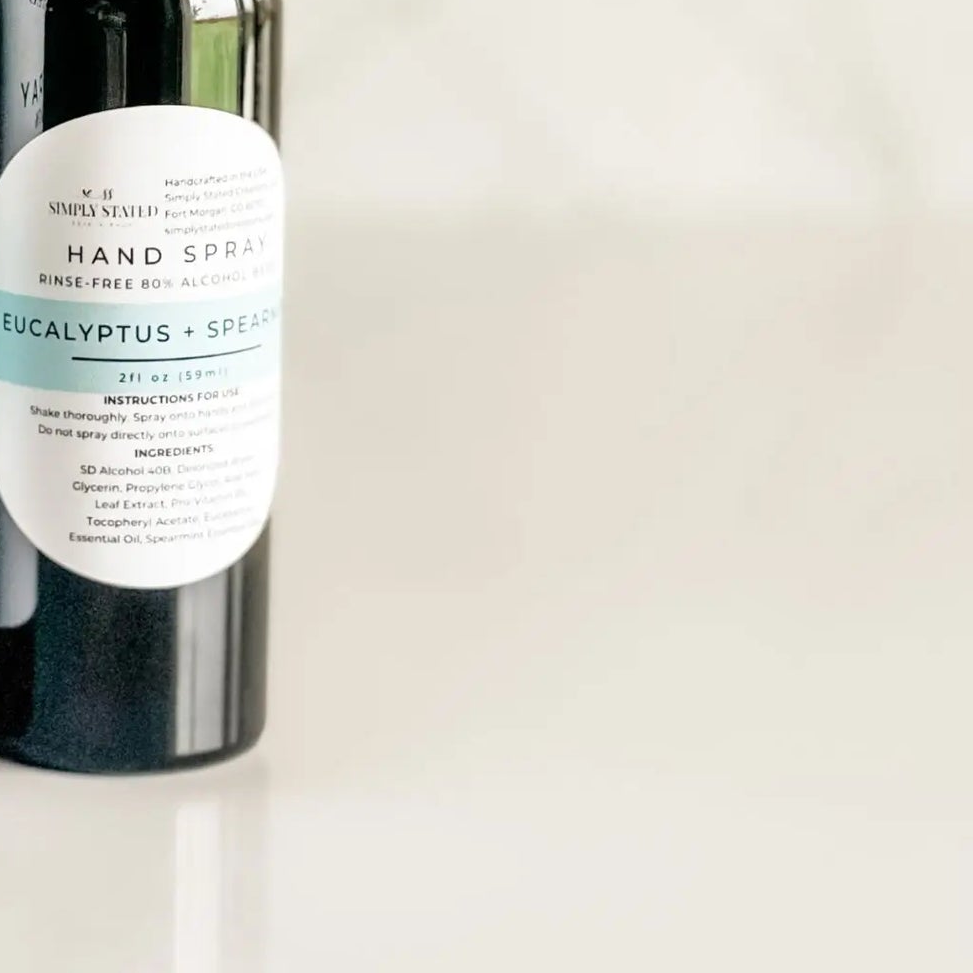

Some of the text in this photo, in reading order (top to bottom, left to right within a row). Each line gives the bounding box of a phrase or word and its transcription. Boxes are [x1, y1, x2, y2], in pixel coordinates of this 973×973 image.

[49, 201, 158, 218] SIMPLY STATED
[165, 209, 187, 219] Fort
[68, 233, 268, 266] HAND SPRAY
[39, 273, 134, 290] RINSE-FREE
[141, 277, 174, 290] 80%
[3, 313, 170, 343] EUCALYPTUS
[184, 326, 195, 337] +
[119, 373, 141, 383] 2fl
[151, 373, 168, 383] oz
[104, 393, 194, 406] INSTRUCTIONS
[197, 390, 219, 402] FOR
[30, 405, 60, 419] Shake
[133, 412, 166, 423] Spray
[38, 423, 52, 435] Do
[55, 427, 73, 437] not
[76, 429, 107, 442] spray
[110, 428, 156, 441] directly
[134, 443, 214, 458] INGREDIENTS
[80, 465, 97, 475] SD
[99, 465, 144, 476] Alcohol
[95, 500, 120, 510] Leaf
[87, 516, 152, 528] Tocopheryl
[69, 532, 120, 544] Essential
[123, 533, 143, 545] Oil,
